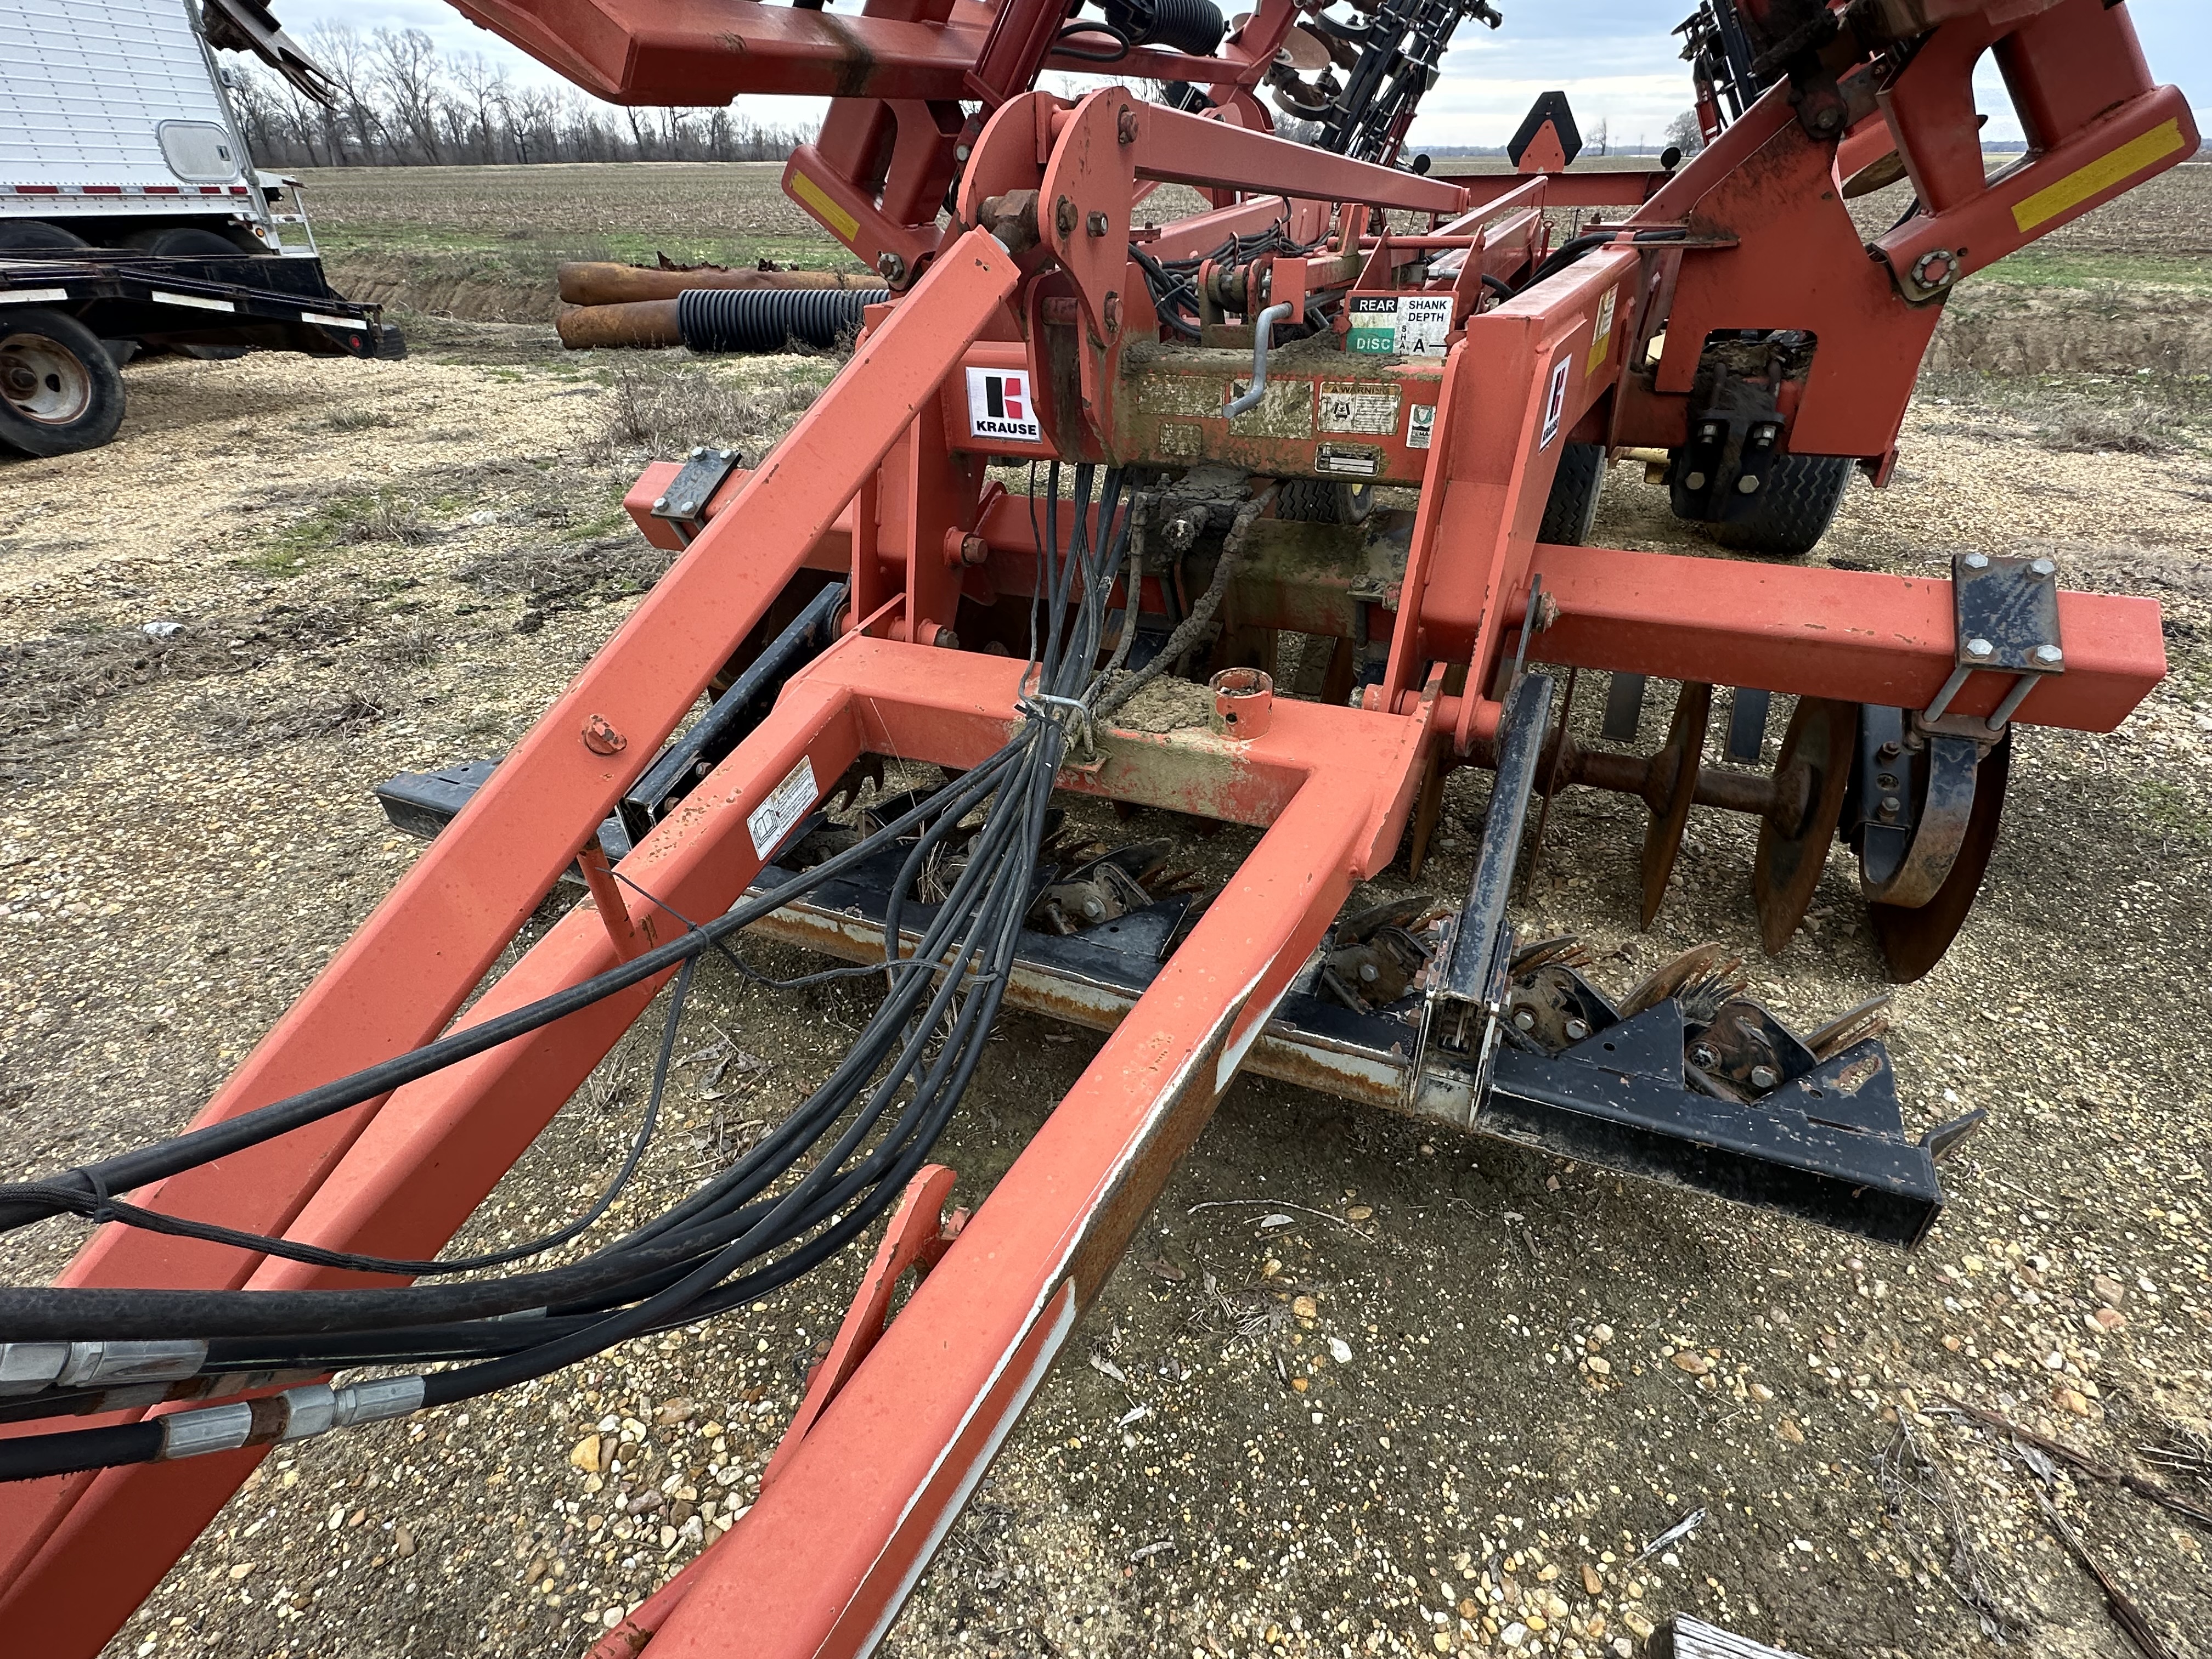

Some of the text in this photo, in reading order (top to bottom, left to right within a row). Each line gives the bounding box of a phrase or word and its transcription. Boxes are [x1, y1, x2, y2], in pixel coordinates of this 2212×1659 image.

[1359, 300, 1395, 311] REAR
[1409, 301, 1447, 309] SHANK
[1408, 313, 1444, 321] DEPTH
[1356, 337, 1390, 350] DISC
[1413, 338, 1425, 353] A
[977, 420, 1037, 435] KRAUSE
